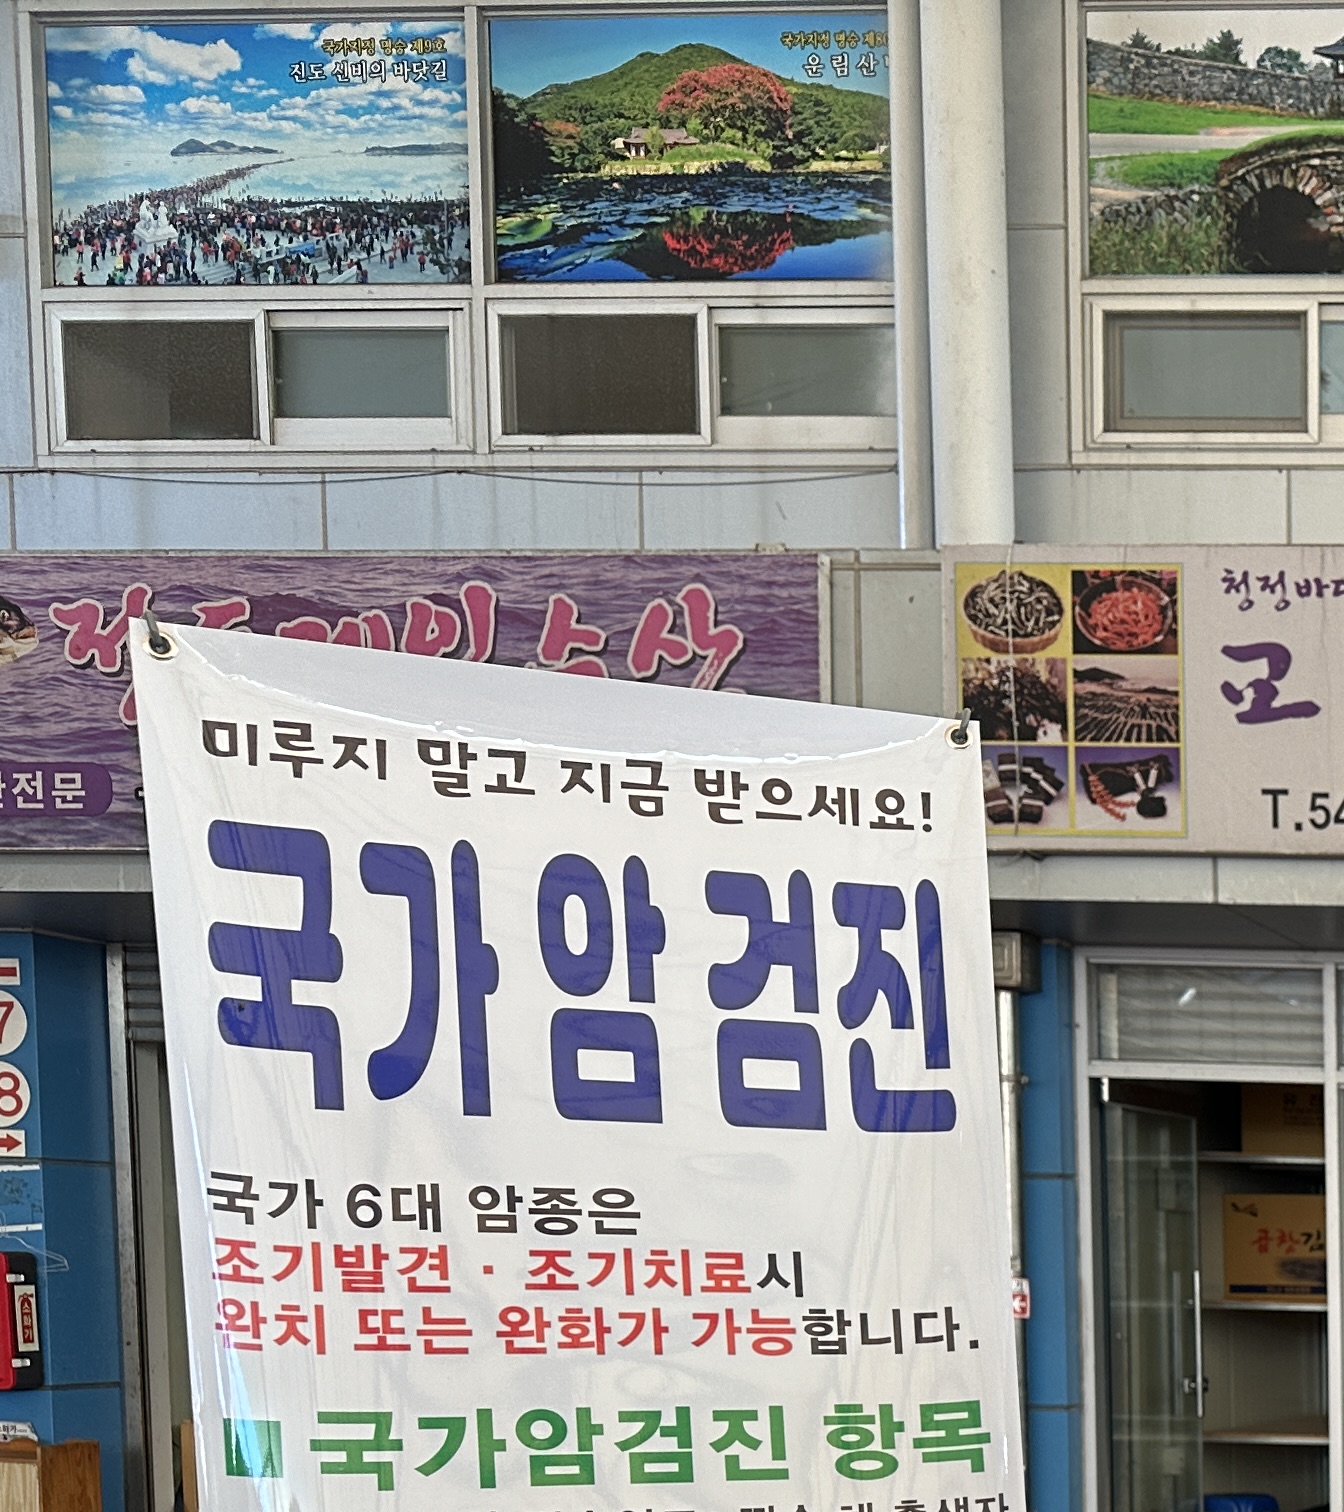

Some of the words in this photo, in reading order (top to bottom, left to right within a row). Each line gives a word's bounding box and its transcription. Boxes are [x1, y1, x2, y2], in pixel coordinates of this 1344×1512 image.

[321, 37, 376, 56] 국가지정
[379, 38, 408, 55] 명승
[780, 30, 830, 50] 국가지정
[833, 31, 860, 50] 명승
[289, 60, 327, 83] 진도
[332, 59, 387, 83] 신비의
[393, 60, 448, 83] 바닷길
[202, 719, 389, 782] 미루지
[416, 739, 536, 796] 말고
[560, 758, 670, 817] 지금
[695, 768, 934, 834] 받으세요!
[207, 1170, 324, 1228] 국가
[346, 1182, 442, 1233] 6대
[467, 1184, 641, 1236] 암종은
[213, 1238, 452, 1294] 조기발견
[525, 1248, 805, 1298] 조기치료시
[22, 1301, 34, 1341] 소화기
[214, 1303, 327, 1357] 완치
[354, 1307, 473, 1355] 또는
[496, 1308, 669, 1356] 완화가
[691, 1306, 980, 1356] 가능합니다.
[309, 1403, 788, 1490] 국가암검진
[823, 1399, 992, 1478] 항목
